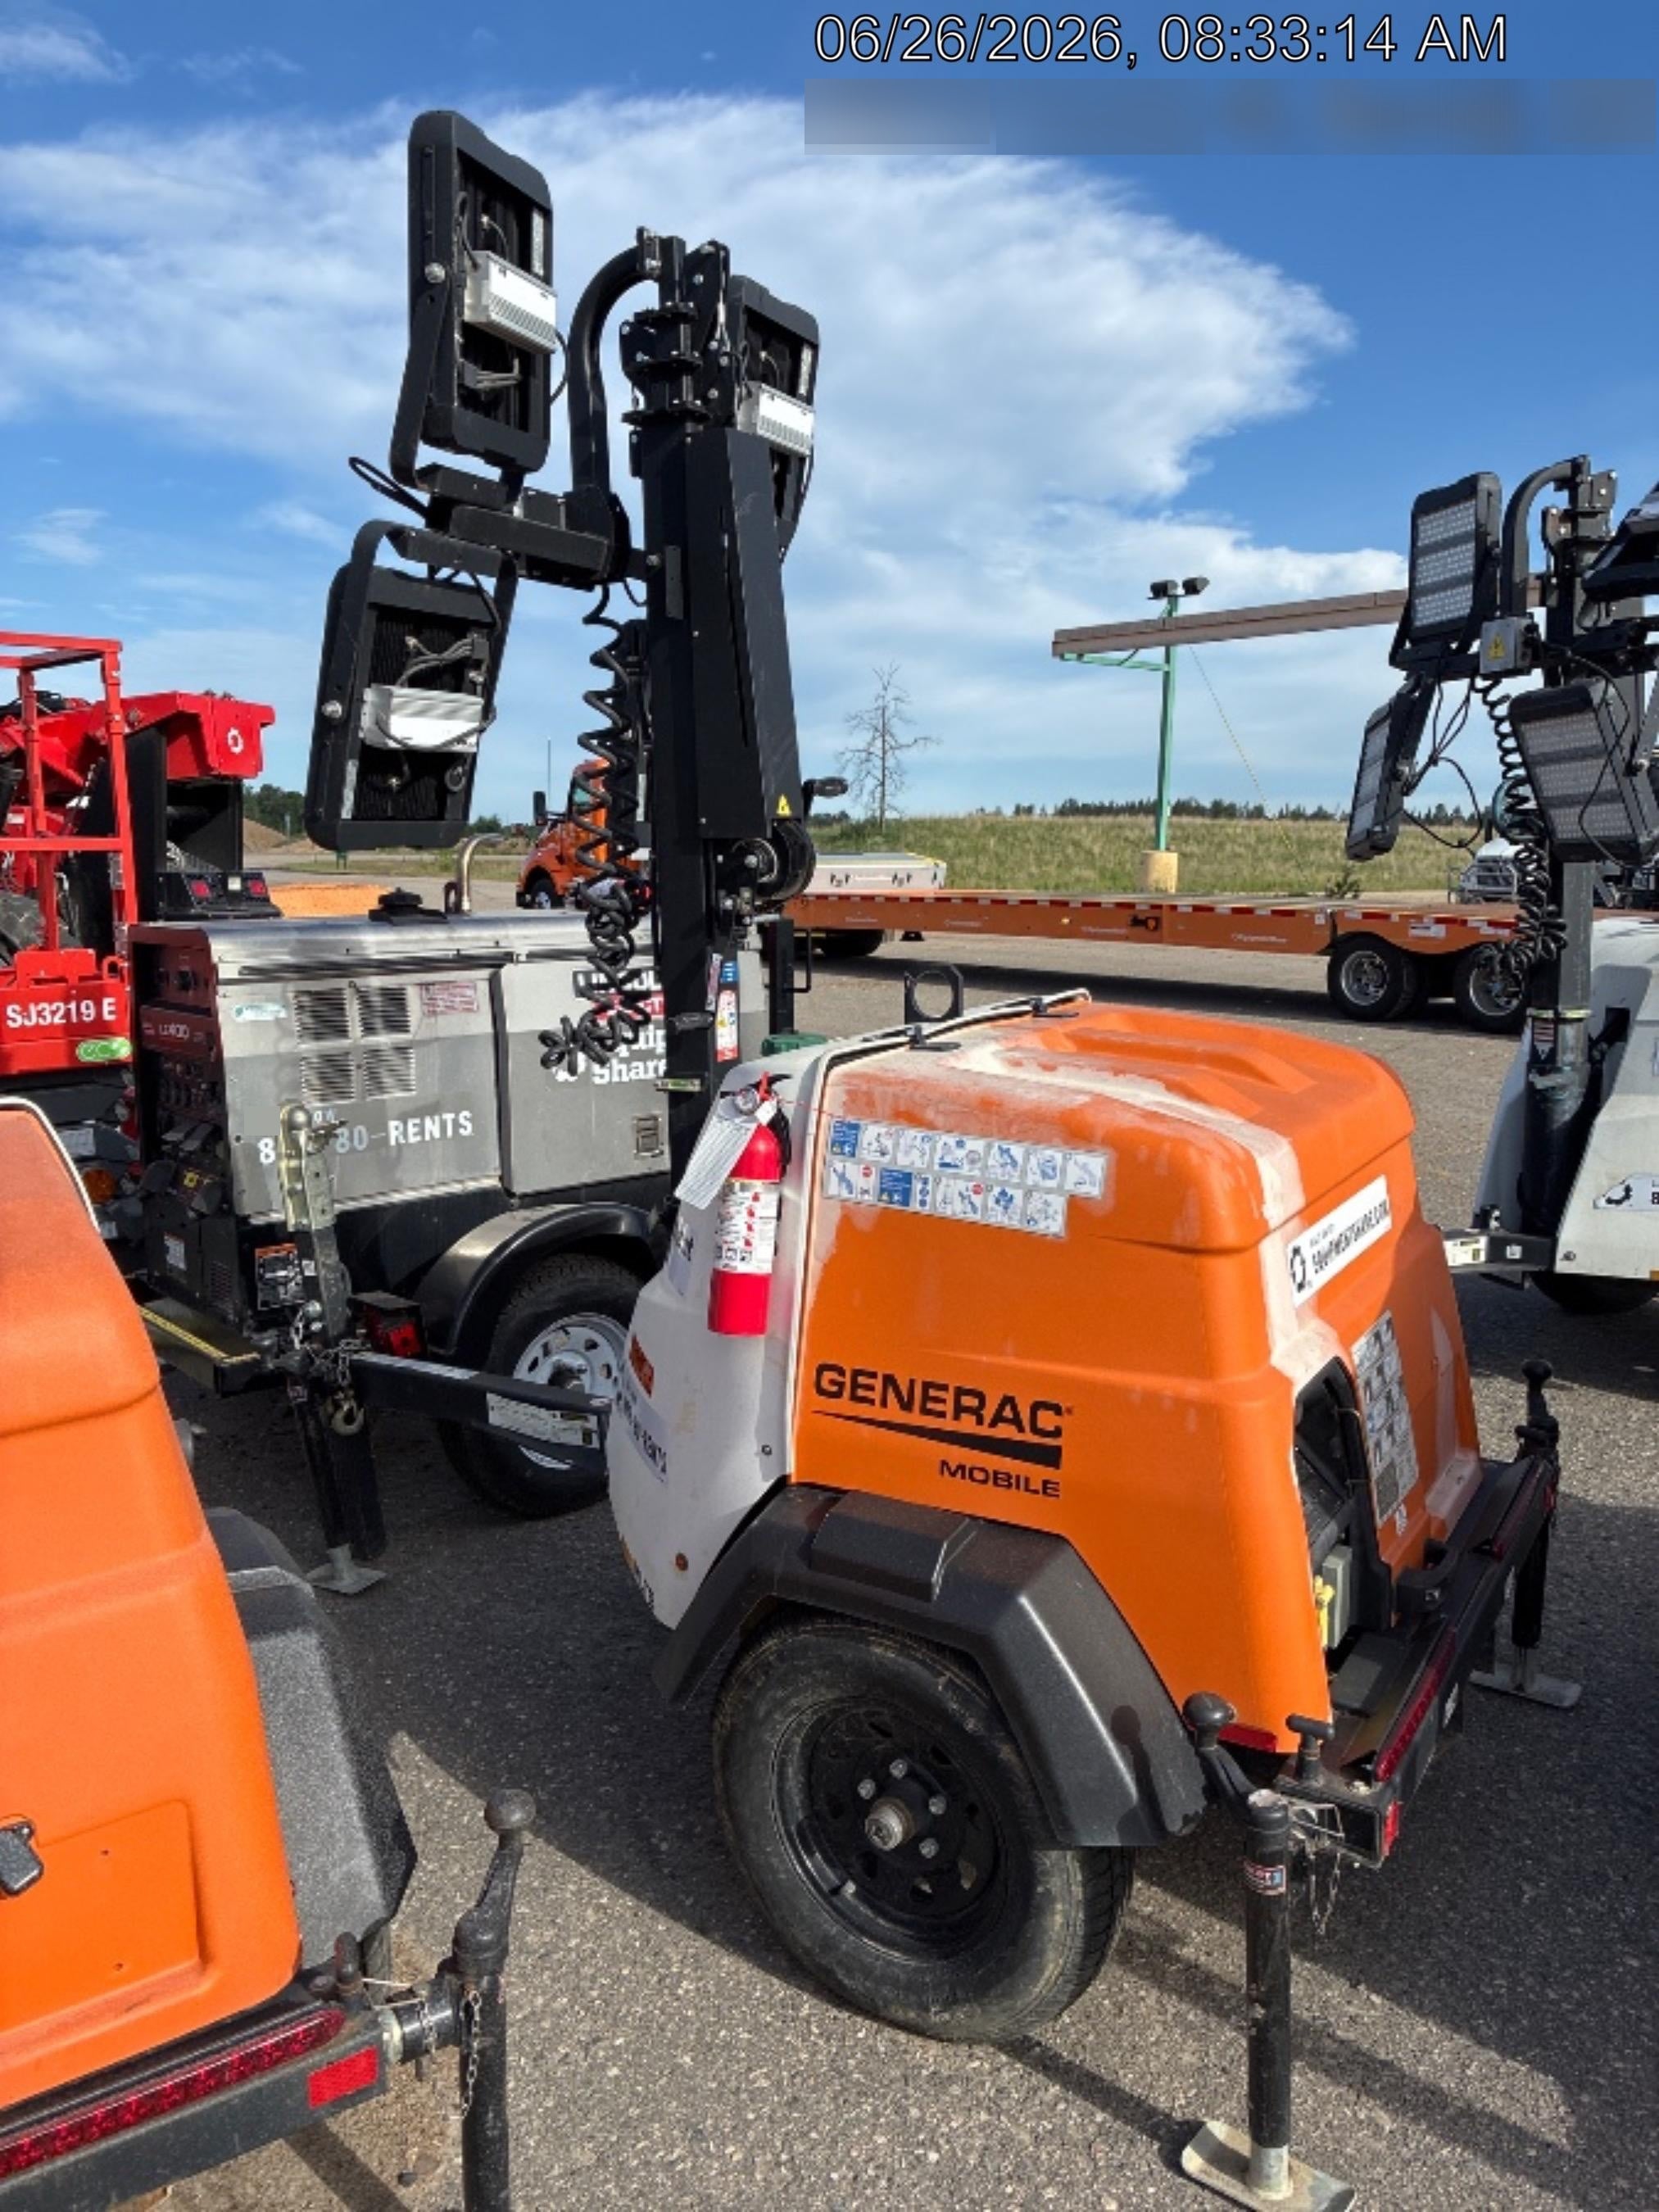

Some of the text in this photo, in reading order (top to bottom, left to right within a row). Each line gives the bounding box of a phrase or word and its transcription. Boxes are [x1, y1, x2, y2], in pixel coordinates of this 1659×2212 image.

[7, 997, 116, 1028] SJ3219 E
[815, 1362, 1063, 1439] GENERAC
[939, 1459, 1061, 1498] MOBILE
